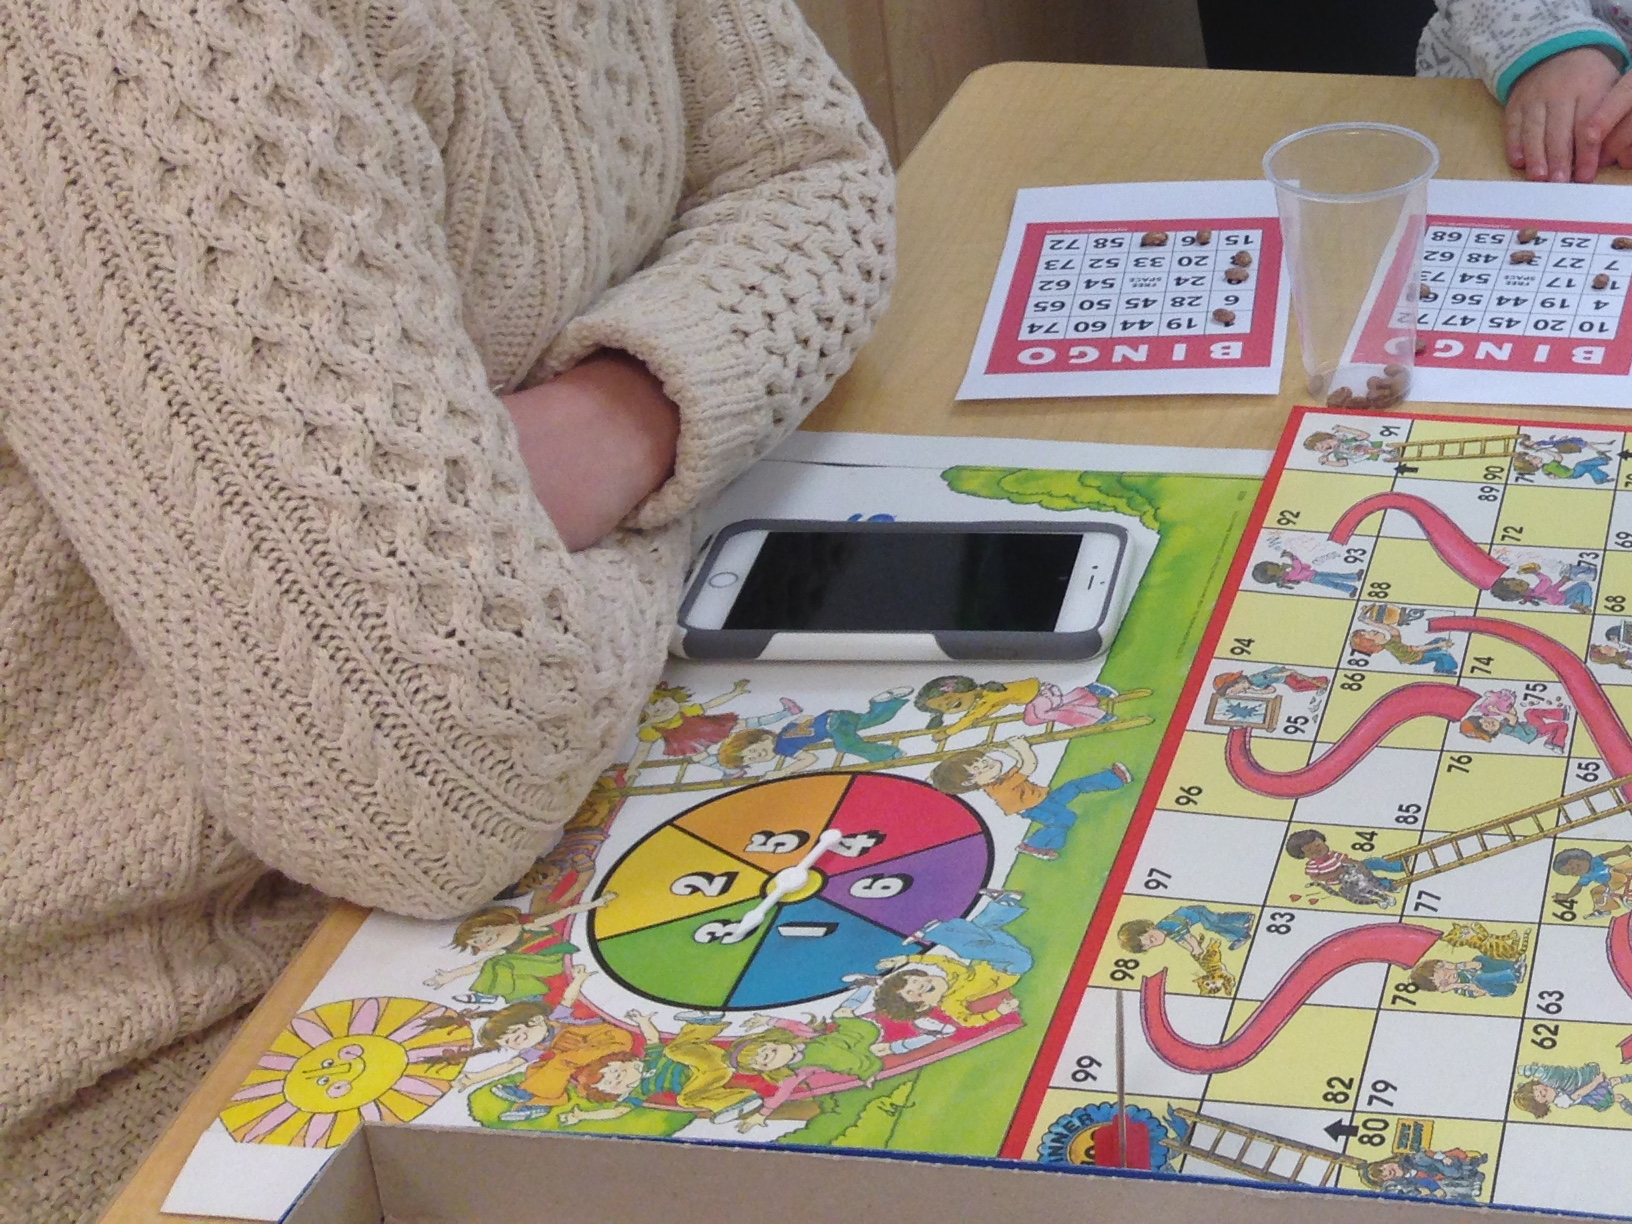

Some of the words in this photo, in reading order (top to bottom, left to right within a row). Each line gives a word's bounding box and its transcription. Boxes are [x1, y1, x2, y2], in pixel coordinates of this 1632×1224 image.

[1225, 235, 1254, 245] 15
[1432, 231, 1462, 241] 68
[1475, 233, 1505, 244] 53
[1049, 239, 1080, 250] 72
[1093, 237, 1125, 248] 58
[1561, 237, 1592, 248] 25
[1134, 257, 1165, 267] 33
[1178, 256, 1209, 267] 20
[1424, 251, 1455, 261] 62
[1467, 253, 1499, 263] 48
[1044, 259, 1075, 270] 73
[1089, 258, 1120, 268] 52
[1552, 257, 1586, 268] 27
[1604, 260, 1619, 270] 7
[1039, 279, 1071, 290] 62
[1084, 278, 1115, 289] 54
[1174, 276, 1206, 286] 24
[1460, 273, 1491, 284] 54
[1547, 278, 1576, 288] 17
[1079, 299, 1112, 310] 50
[1125, 298, 1158, 308] 45
[1171, 296, 1202, 307] 28
[1224, 295, 1239, 305] 6
[1452, 294, 1483, 305] 56
[1495, 296, 1529, 306] 44
[1541, 298, 1569, 309] 19
[1593, 300, 1609, 310] 4
[1033, 301, 1065, 312] 65
[1074, 321, 1106, 332] 60
[1120, 319, 1153, 331] 44
[1166, 317, 1197, 329] 19
[1443, 315, 1476, 326] 47
[1489, 317, 1521, 328] 45
[1533, 319, 1567, 331] 20
[1578, 321, 1609, 332] 10
[1027, 322, 1059, 334] 74
[1017, 341, 1243, 365] BINGO
[1484, 466, 1504, 480] 90
[1478, 486, 1499, 502] 89
[1277, 509, 1300, 526] 92
[1501, 525, 1523, 542] 72
[1344, 547, 1367, 564] 93
[1368, 582, 1391, 599] 88
[1604, 595, 1626, 612] 68
[1231, 637, 1255, 656] 94
[1471, 656, 1494, 674] 74
[1340, 672, 1365, 692] 86
[1283, 715, 1309, 735] 95
[1447, 754, 1472, 774] 76
[1577, 761, 1600, 781] 65
[1175, 785, 1202, 806] 96
[1395, 803, 1421, 824] 85
[744, 829, 810, 855] 5
[834, 830, 887, 858] 4
[1351, 830, 1379, 852] 84
[671, 870, 738, 897] 2
[1144, 867, 1172, 890] 97
[849, 873, 914, 899] 6
[1414, 889, 1442, 913] 77
[1266, 912, 1296, 934] 83
[694, 919, 752, 945] 3
[777, 922, 839, 937] 1
[1110, 958, 1140, 981] 98
[1537, 990, 1564, 1015] 63
[1532, 1022, 1559, 1049] 62
[1071, 1055, 1102, 1082] 99
[1323, 1076, 1354, 1104] 82
[1367, 1079, 1397, 1107] 79
[1047, 1113, 1095, 1162] INNER
[1358, 1118, 1389, 1146] 80
